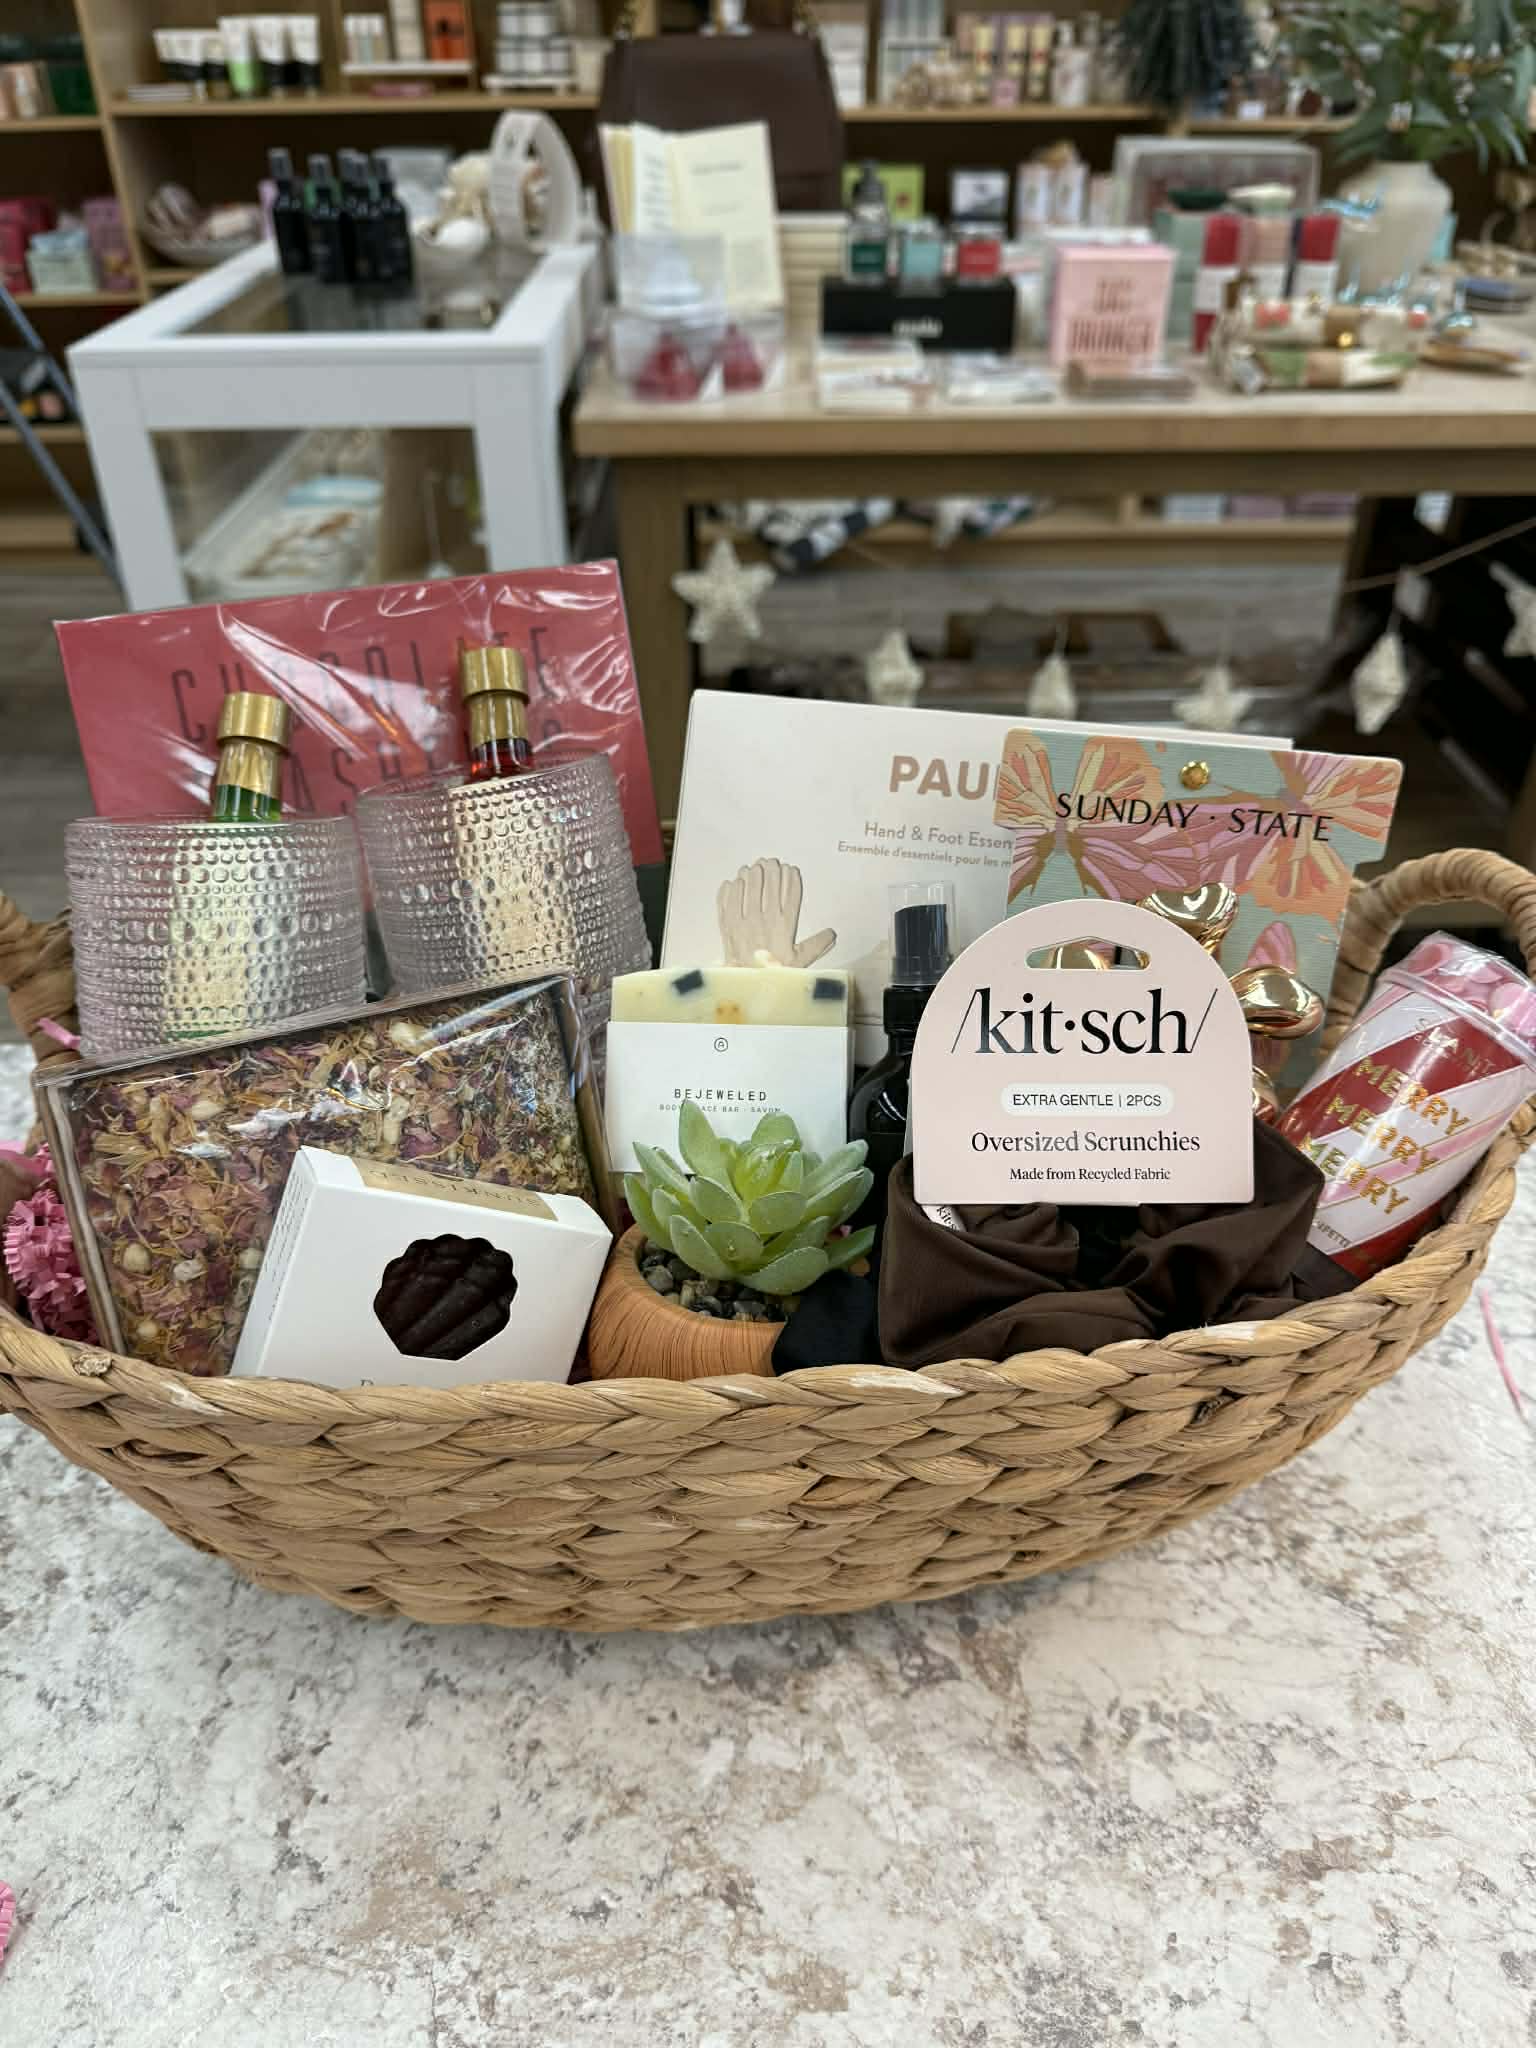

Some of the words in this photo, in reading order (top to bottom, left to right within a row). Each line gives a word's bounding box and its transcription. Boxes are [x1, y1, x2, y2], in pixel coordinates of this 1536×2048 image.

[888, 754, 1000, 801] PAU
[1054, 791, 1200, 829] SUNDAY
[1228, 808, 1334, 842] STATE
[864, 820, 906, 840] Hand
[911, 824, 923, 842] &
[928, 827, 964, 846] Foot
[837, 840, 890, 857] Ensemble
[955, 855, 981, 867] pour
[674, 1088, 767, 1102] BEJEWELED
[1012, 1094, 1057, 1107] EXTRA
[1060, 1094, 1114, 1107] GENTLE
[1126, 1094, 1162, 1107] 2PCS
[1355, 1055, 1472, 1136] MERRY
[971, 1130, 1079, 1152] Oversized
[1084, 1130, 1201, 1152] Scrunchies
[1325, 1093, 1439, 1174] MERRY
[1009, 1168, 1044, 1181] Made
[1046, 1167, 1076, 1181] from
[1078, 1167, 1132, 1184] Recycled
[1134, 1167, 1171, 1181] Fabric
[1296, 1131, 1410, 1215] MERRY
